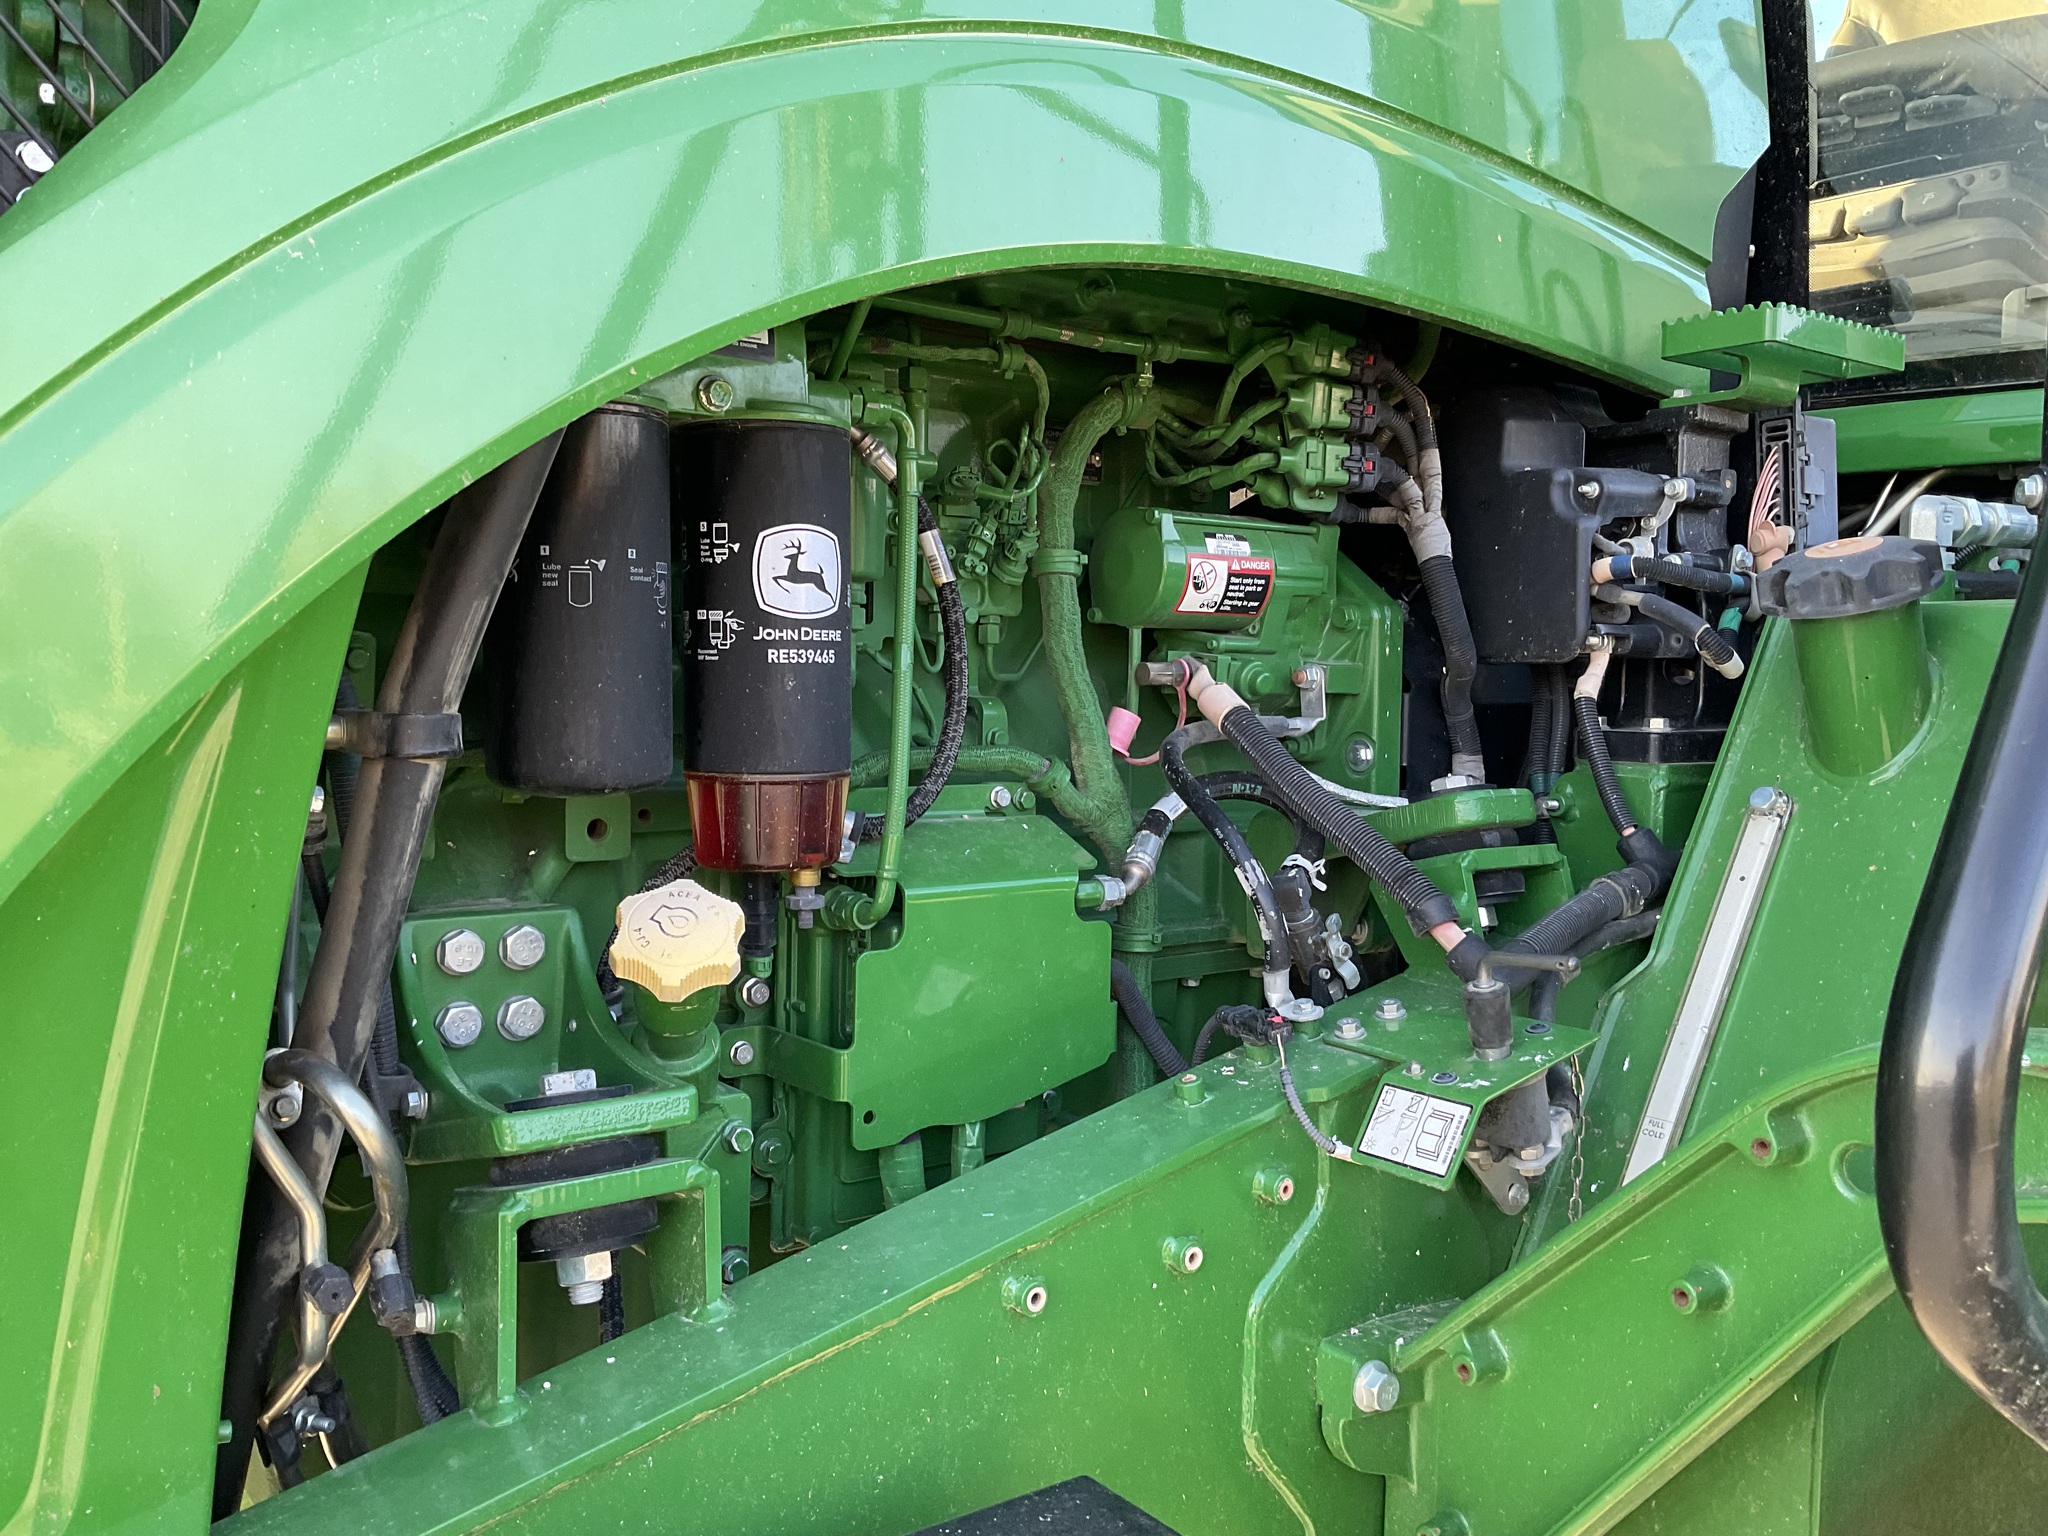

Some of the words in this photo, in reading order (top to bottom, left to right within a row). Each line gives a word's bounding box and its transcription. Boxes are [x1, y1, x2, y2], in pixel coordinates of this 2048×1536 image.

[1241, 560, 1270, 570] DANGER
[1242, 577, 1254, 585] only
[753, 626, 798, 640] JOHN
[800, 627, 842, 642] DEERE
[767, 648, 835, 664] RE539465
[668, 890, 701, 901] ACEA
[633, 927, 651, 948] CJ-4
[457, 957, 473, 967] LE
[521, 1005, 537, 1017] LE
[452, 1012, 467, 1028] LE
[1648, 1119, 1665, 1129] FULL
[1642, 1128, 1666, 1140] COLD
